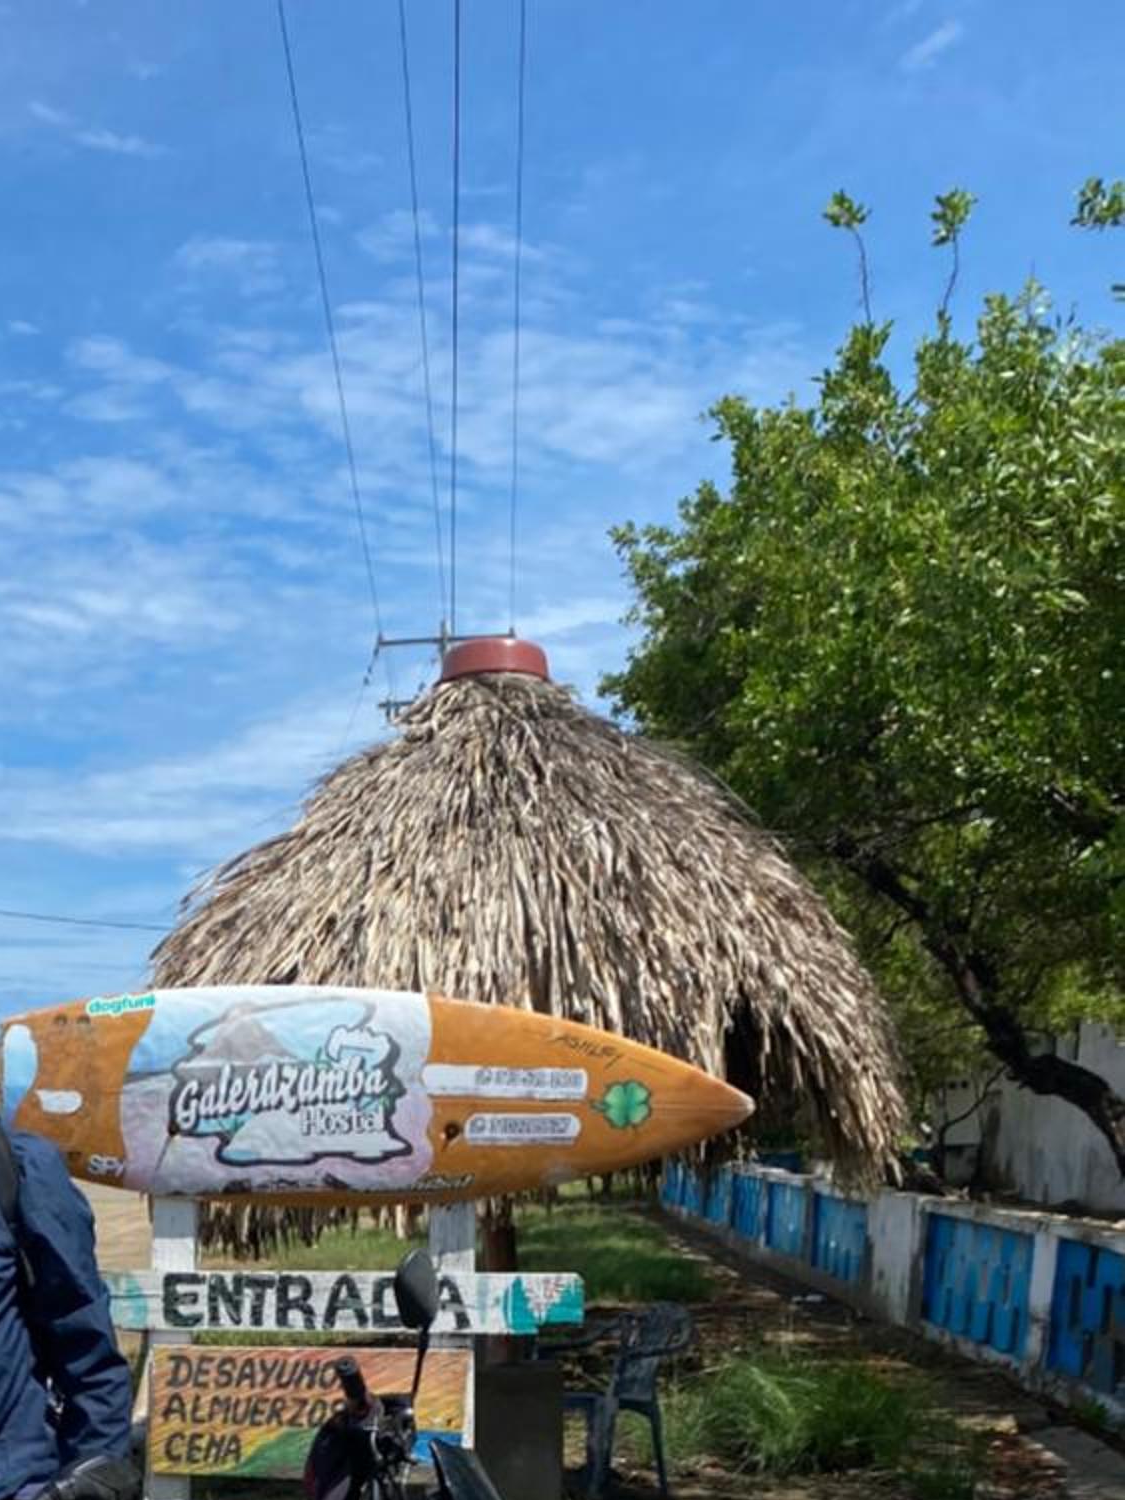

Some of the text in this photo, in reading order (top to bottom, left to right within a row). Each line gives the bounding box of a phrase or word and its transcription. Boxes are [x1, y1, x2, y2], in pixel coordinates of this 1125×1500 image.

[175, 1055, 389, 1130] Galerazamba
[300, 1103, 386, 1137] Hostal
[162, 1272, 471, 1329] ENTRADA
[165, 1355, 342, 1390] DESAYUNO
